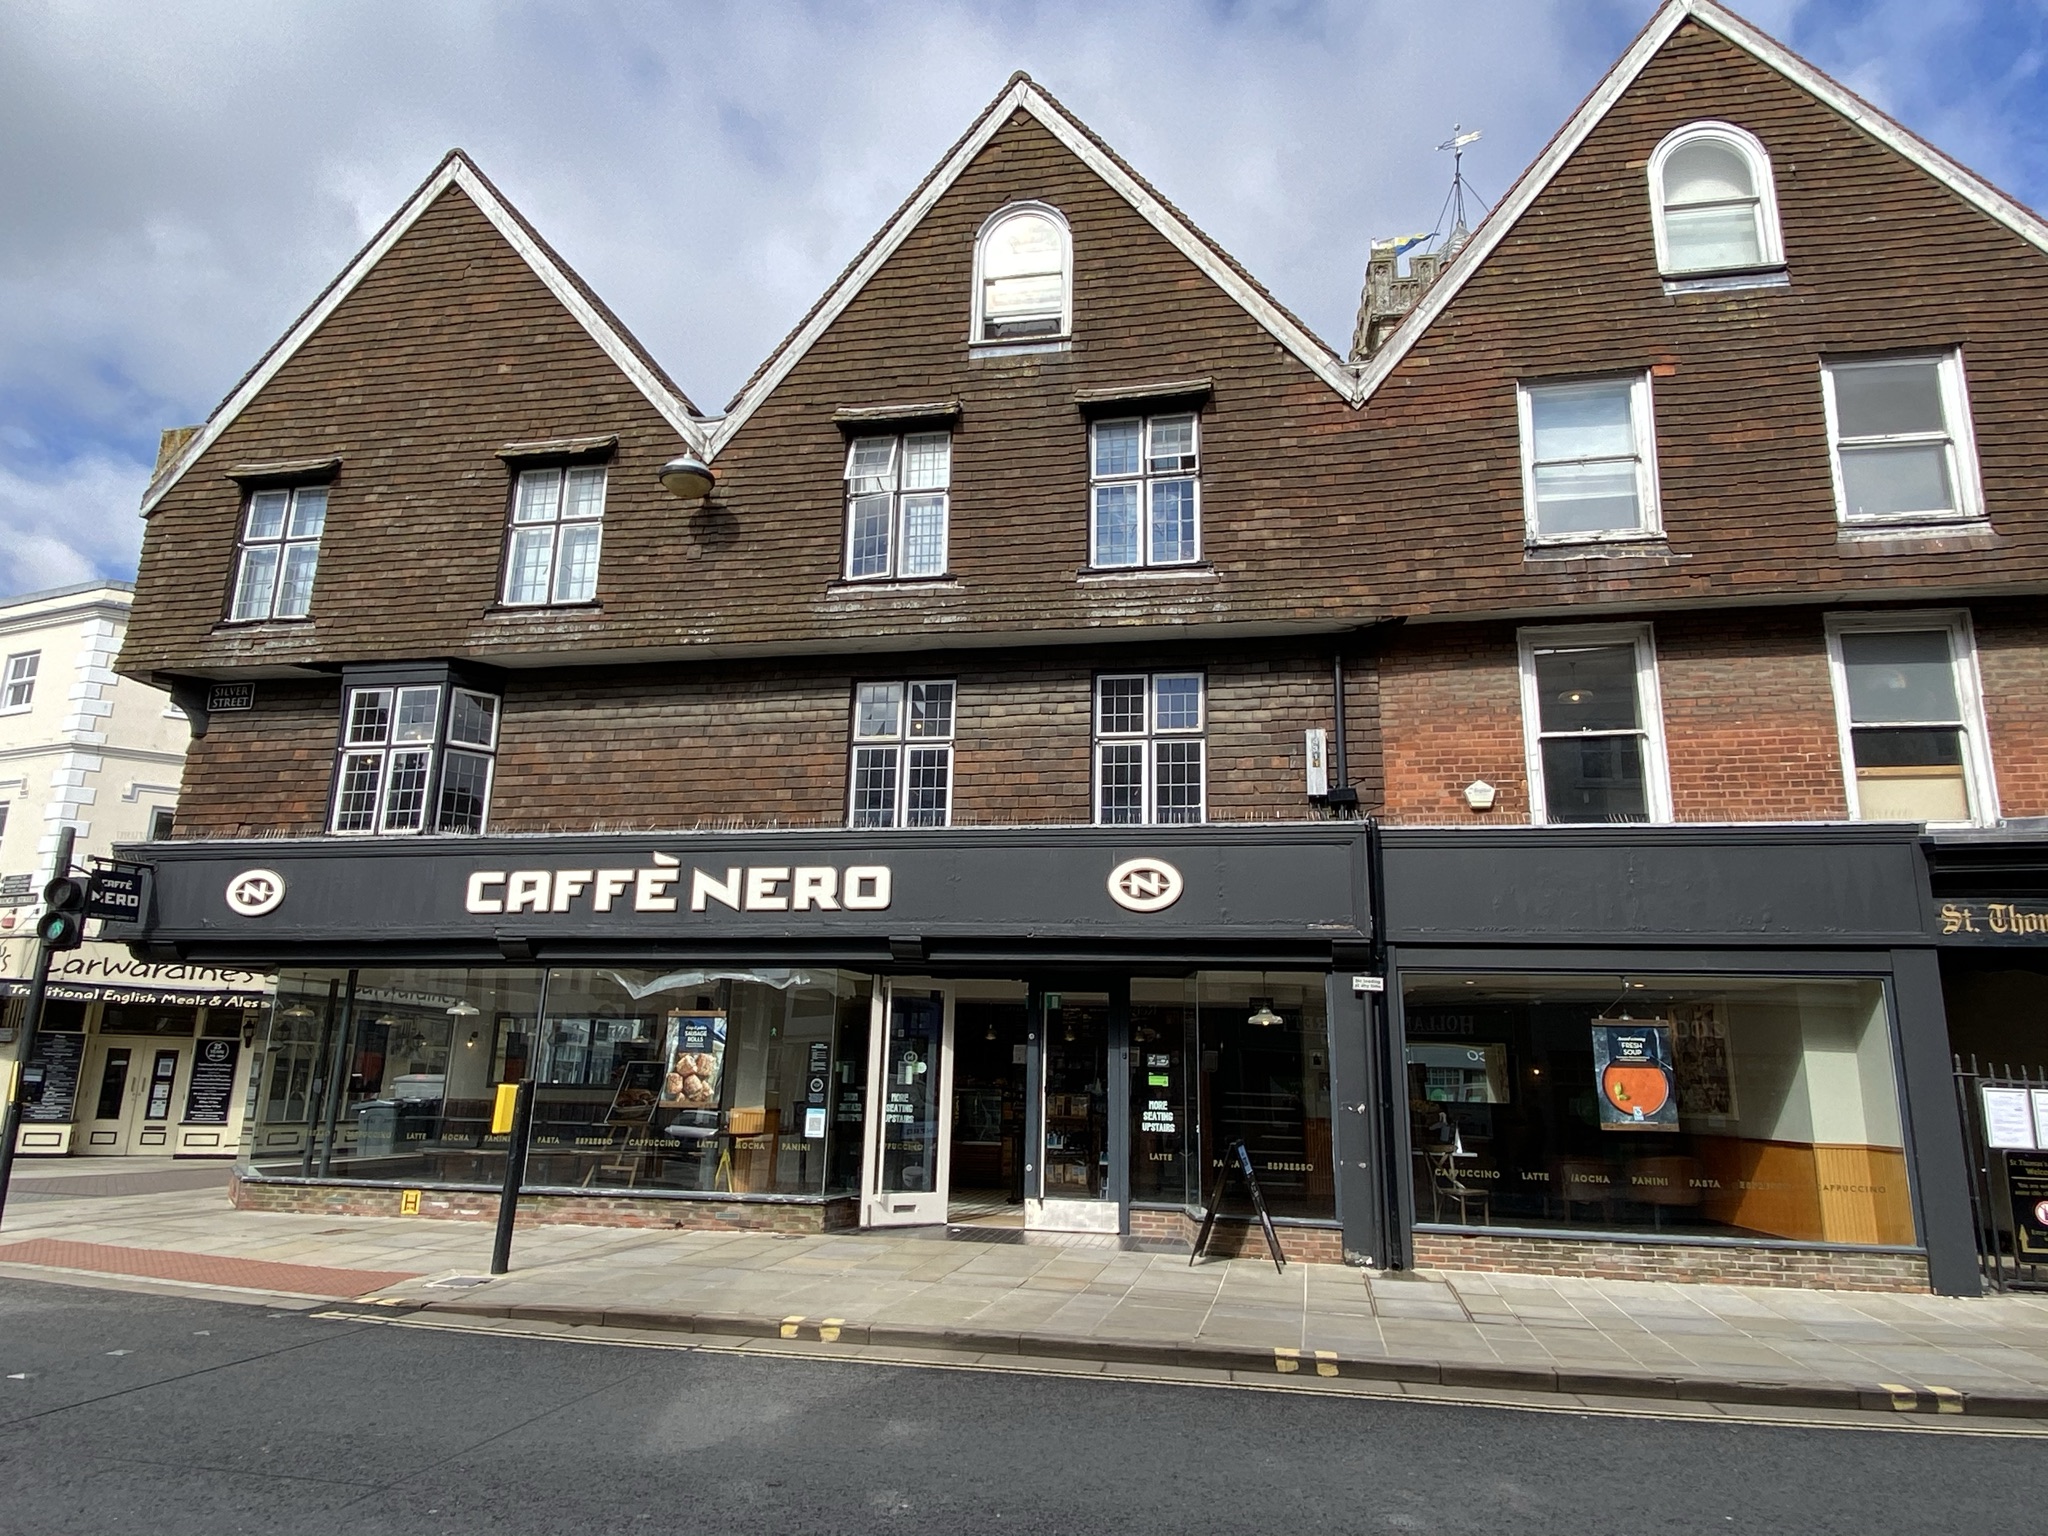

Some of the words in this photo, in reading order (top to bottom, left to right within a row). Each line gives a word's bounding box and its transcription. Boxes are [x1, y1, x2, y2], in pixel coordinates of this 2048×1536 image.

[215, 686, 248, 697] SILVER
[212, 697, 249, 708] STREET
[466, 850, 681, 914] CAFFÈ
[691, 865, 893, 912] NERO
[1941, 903, 1980, 935] St.
[102, 989, 157, 1005] English
[160, 994, 207, 1007] Meals
[208, 995, 222, 1007] &
[224, 996, 260, 1009] Ales
[891, 1093, 909, 1102] MORE
[886, 1103, 914, 1113] SEATING
[1148, 1100, 1168, 1111] MORE
[1143, 1111, 1174, 1121] SEATING
[1141, 1121, 1176, 1133] UPSTAIRS
[406, 1132, 427, 1140] LATTE
[441, 1133, 470, 1142] MOCHA
[537, 1136, 560, 1144] PASTA
[575, 1137, 613, 1146] ESPRESSO
[628, 1138, 681, 1148] CAPPUCCINO
[696, 1140, 719, 1149] LATTE
[781, 1143, 811, 1151] PANINI
[1149, 1153, 1172, 1161] LATTE
[1267, 1162, 1314, 1172] ESPRESSO
[1521, 1172, 1550, 1181] LATTE
[1632, 1176, 1669, 1186] PANINI
[1689, 1179, 1721, 1189] PASTA
